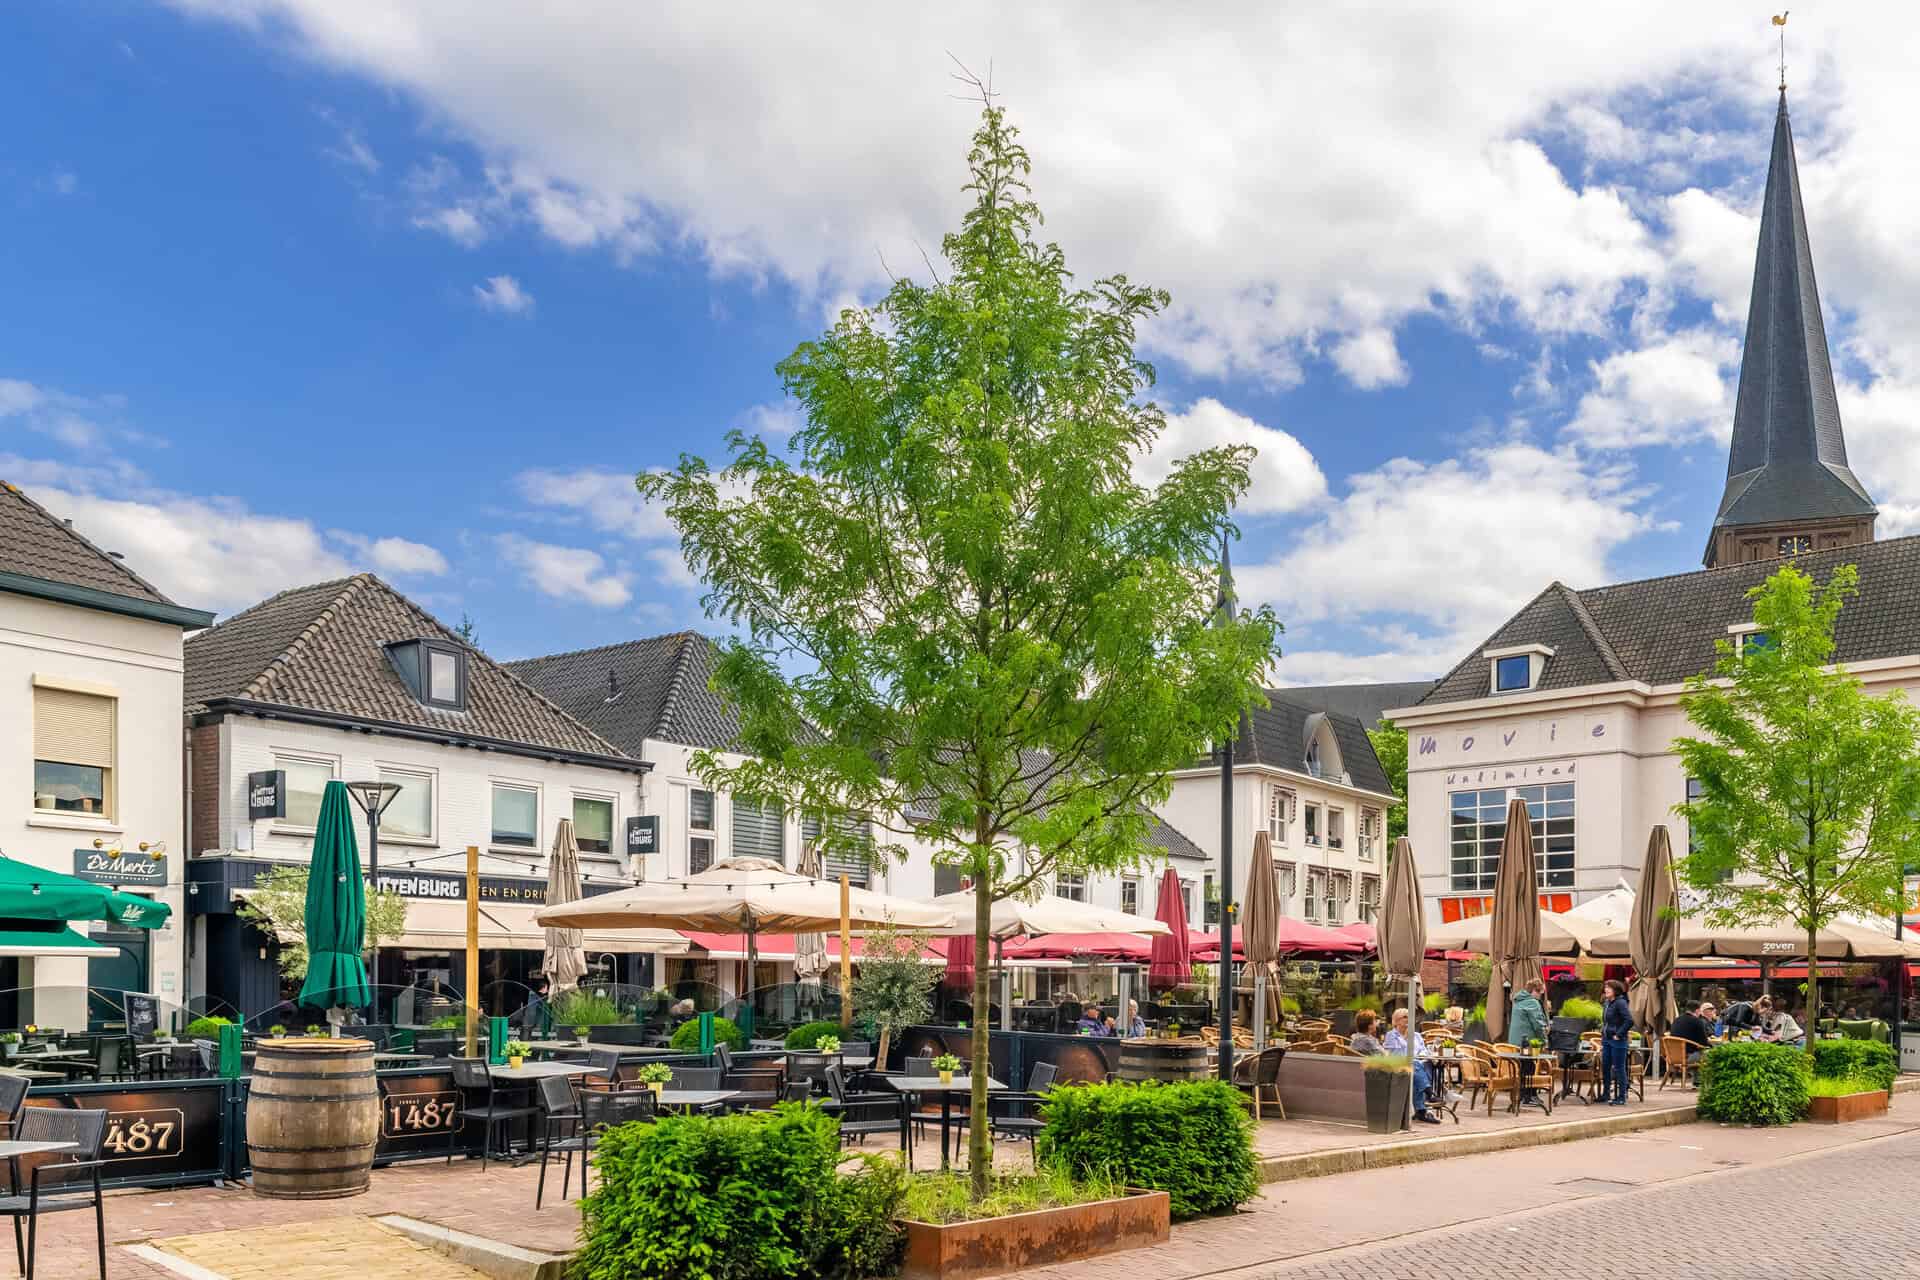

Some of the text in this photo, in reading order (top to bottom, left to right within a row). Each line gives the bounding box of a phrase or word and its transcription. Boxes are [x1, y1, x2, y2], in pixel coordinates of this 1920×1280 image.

[503, 887, 518, 897] EN
[390, 1099, 456, 1130] 1487
[104, 1117, 176, 1153] 487
